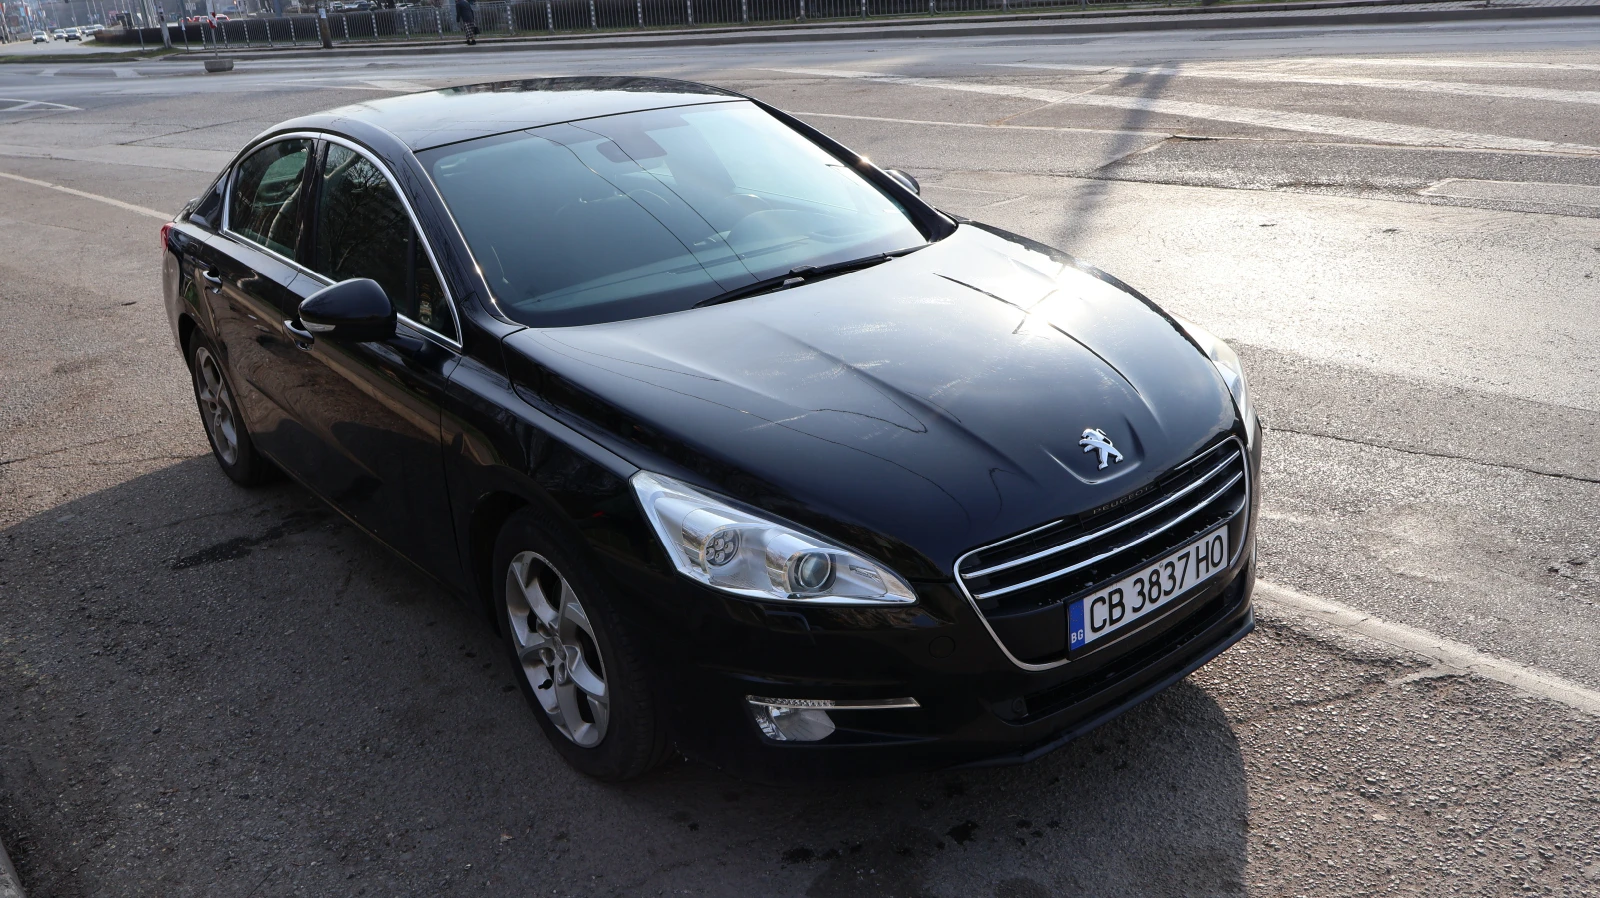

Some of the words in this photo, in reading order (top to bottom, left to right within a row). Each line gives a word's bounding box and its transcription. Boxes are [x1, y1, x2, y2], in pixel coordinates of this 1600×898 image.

[1093, 485, 1154, 514] PEUGEOT
[1090, 587, 1126, 633] CB
[1132, 551, 1191, 613] 3837
[1195, 534, 1224, 579] HO
[1071, 629, 1084, 643] BG
